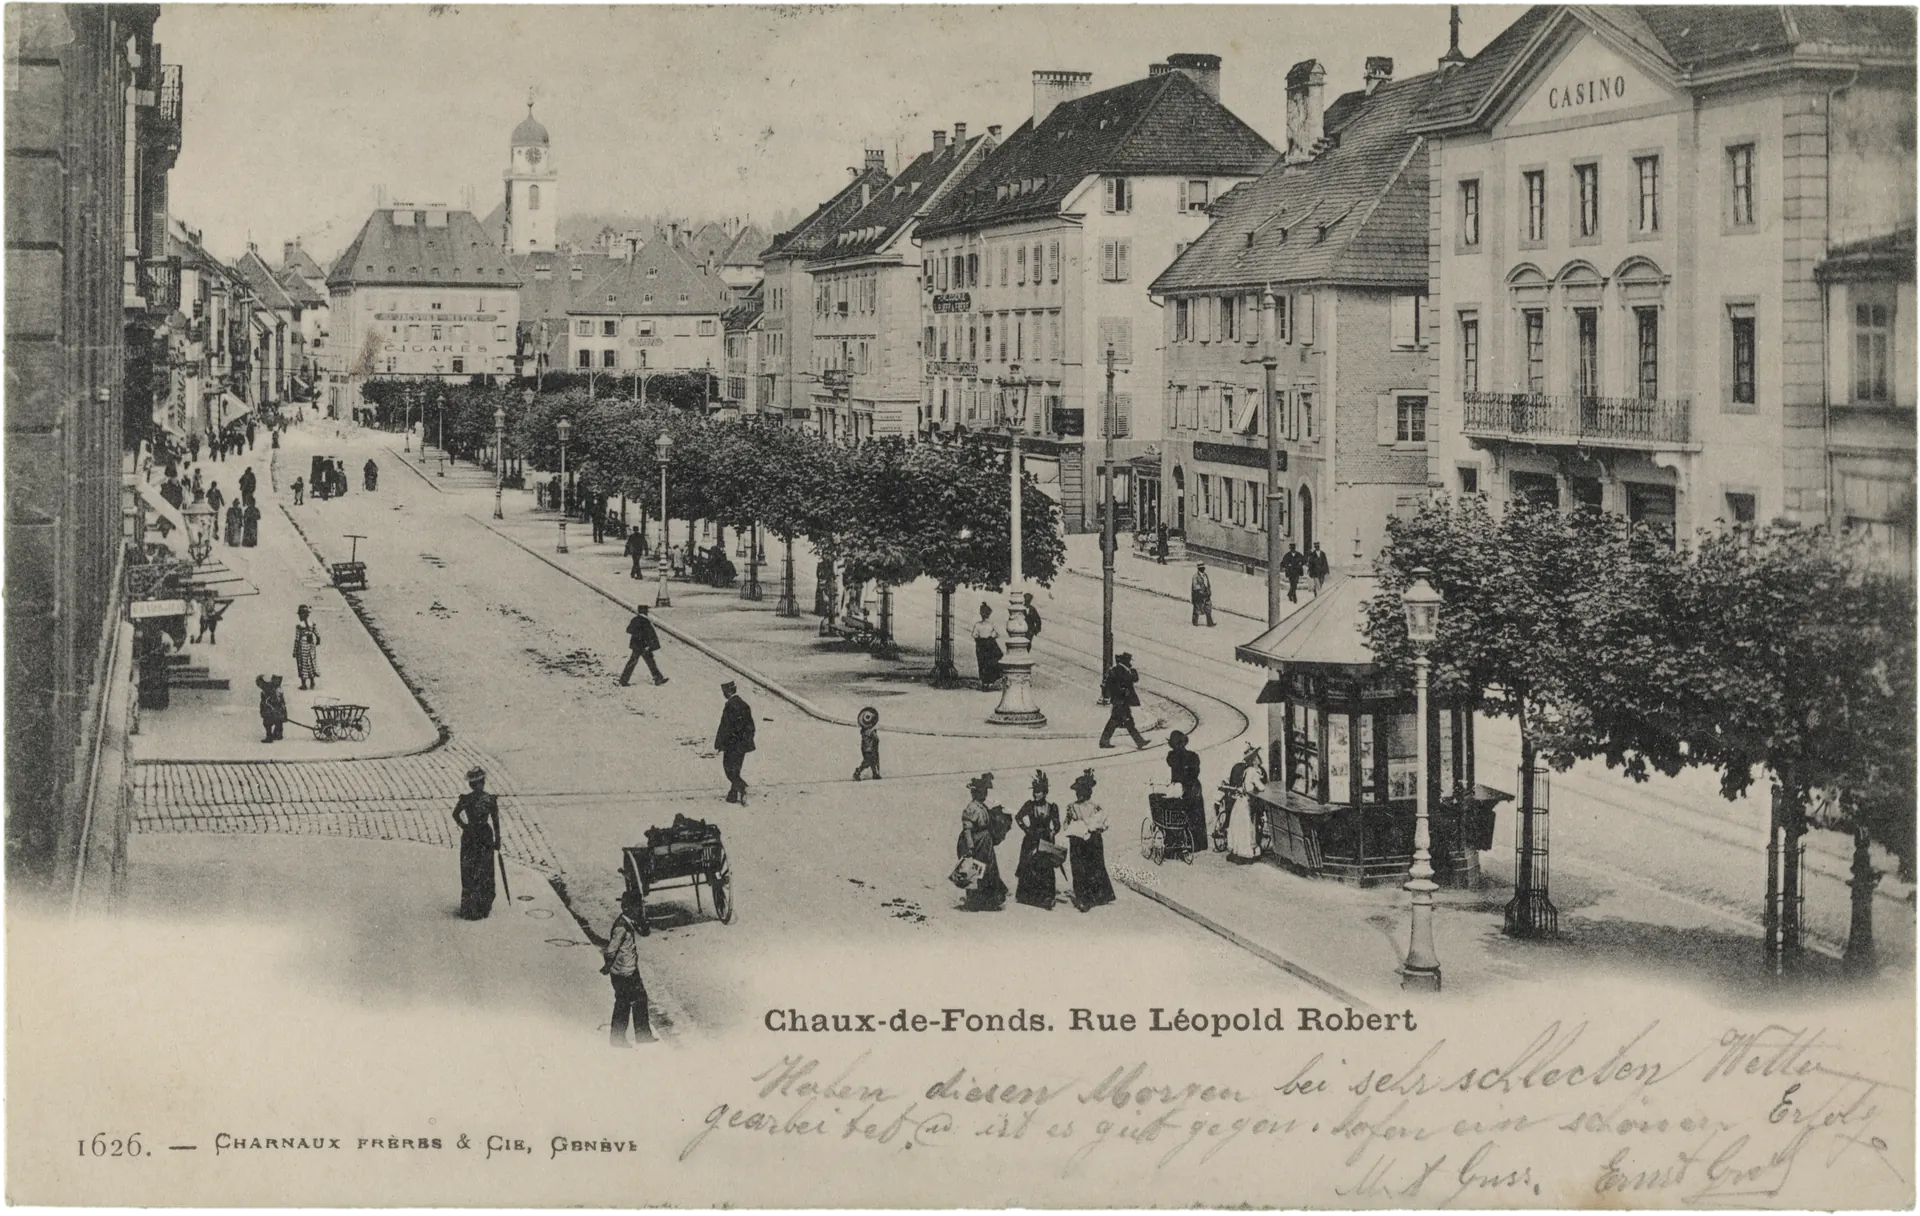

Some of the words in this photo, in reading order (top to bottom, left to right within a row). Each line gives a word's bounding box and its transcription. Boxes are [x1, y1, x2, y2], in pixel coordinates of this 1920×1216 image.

[1549, 76, 1625, 109] CASINO
[384, 344, 488, 353] CIGARES
[1274, 1052, 1347, 1095] bei
